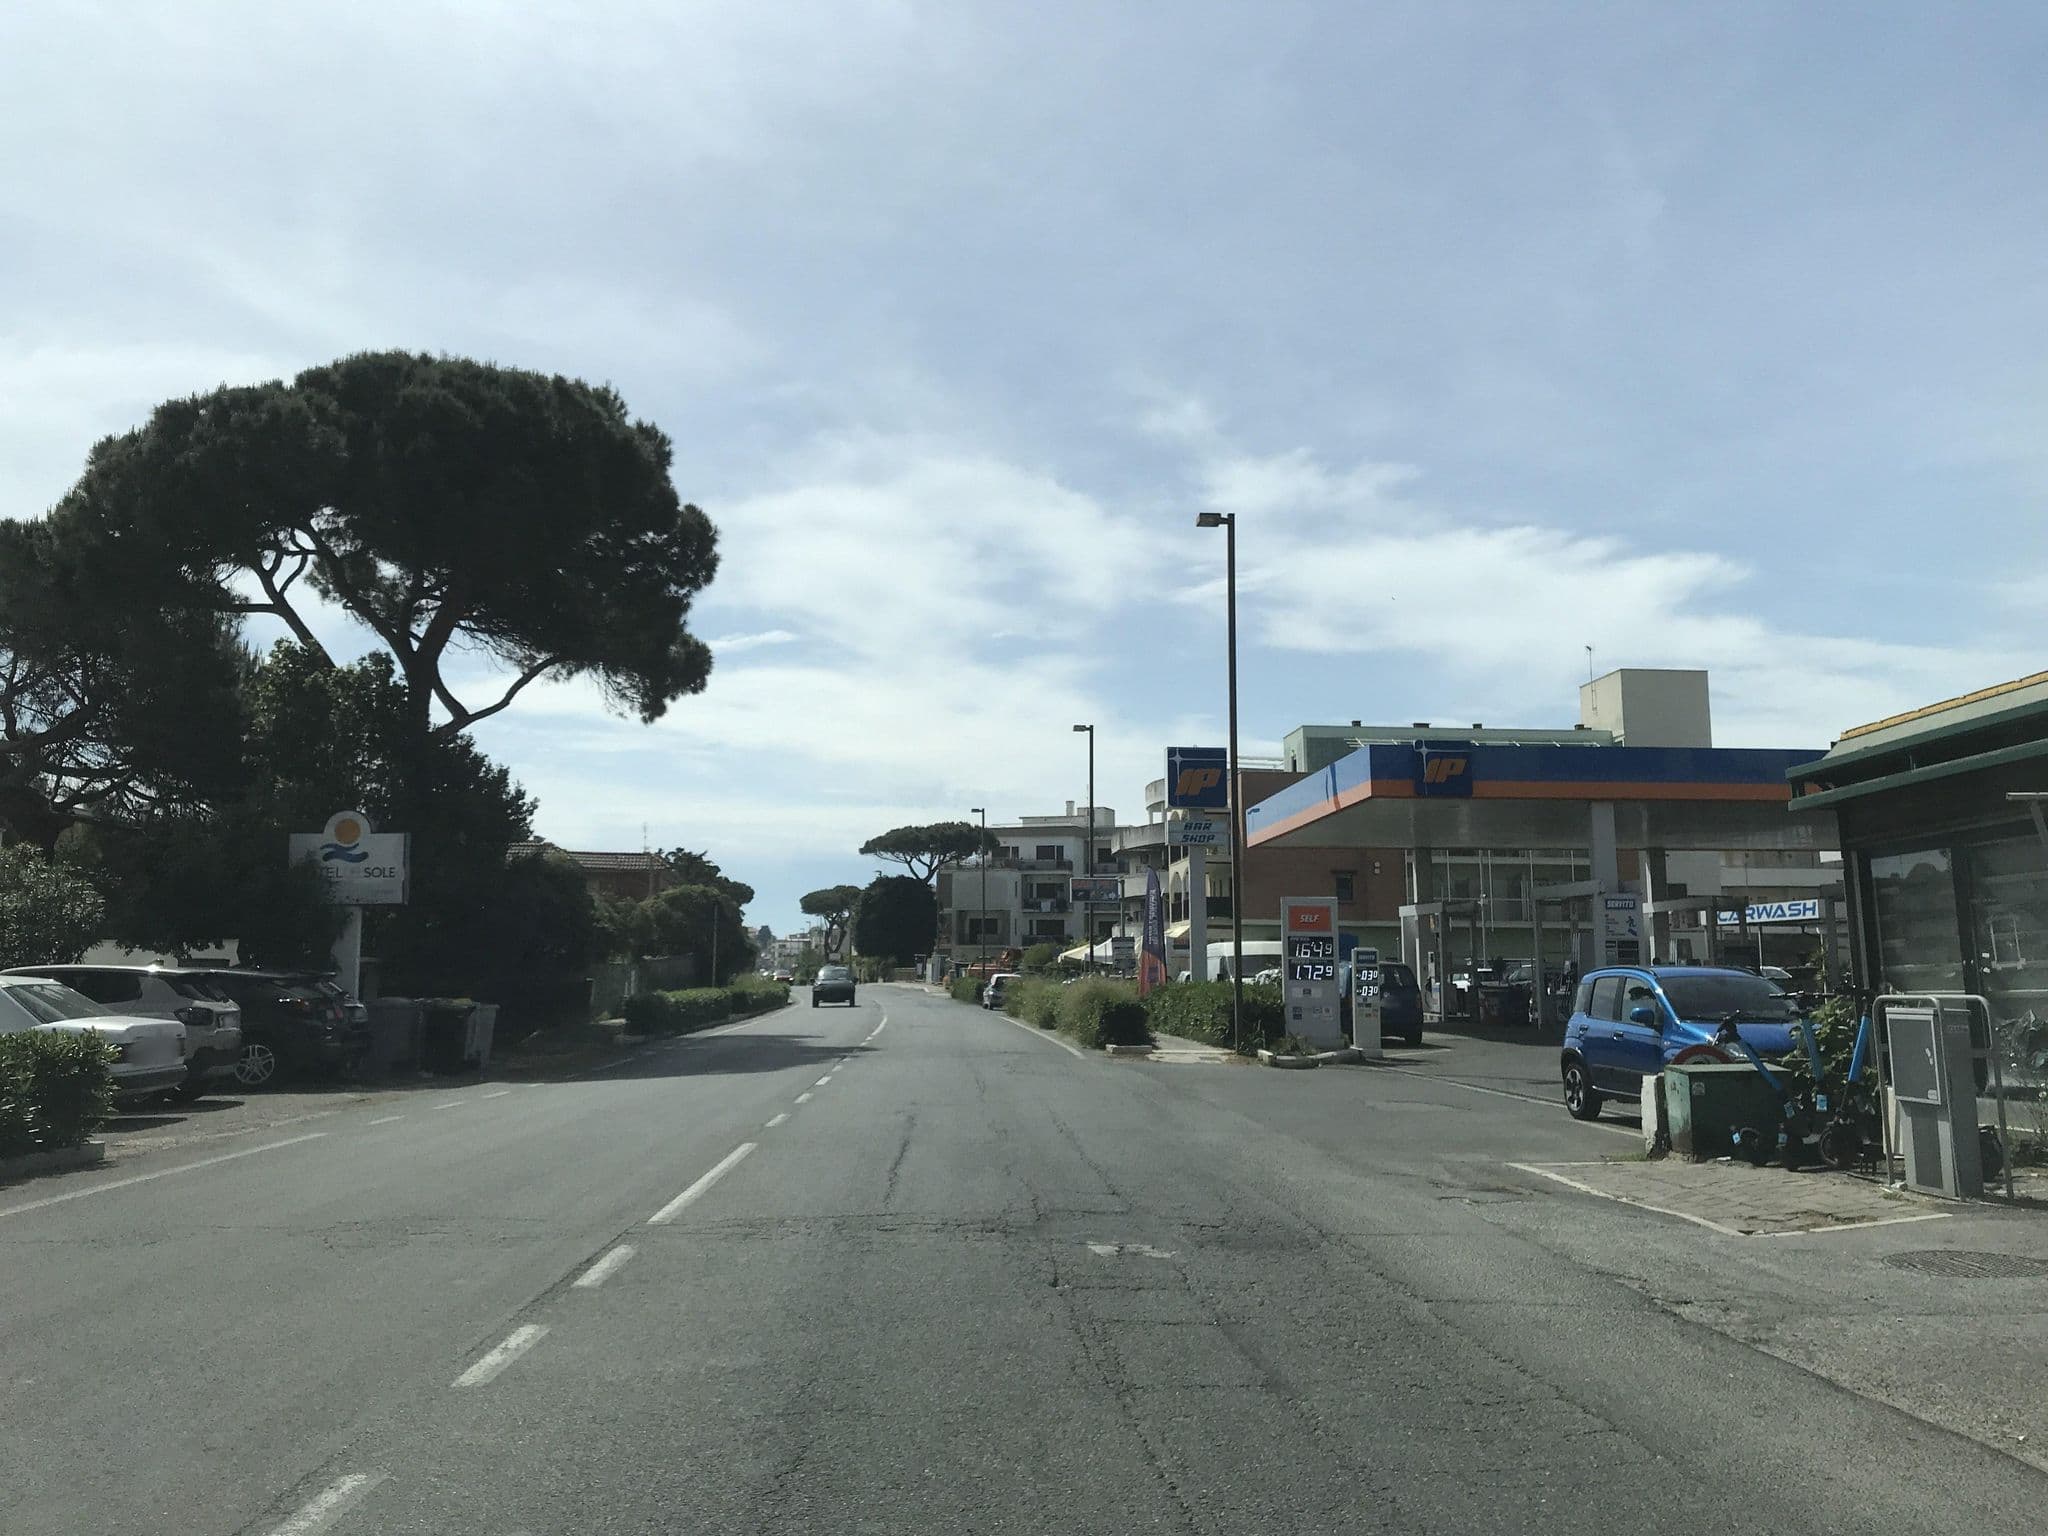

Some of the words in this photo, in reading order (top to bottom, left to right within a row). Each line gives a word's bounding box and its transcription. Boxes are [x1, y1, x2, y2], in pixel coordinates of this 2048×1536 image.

[1424, 758, 1467, 784] IP
[1175, 768, 1223, 796] IP
[1183, 822, 1213, 831] BAR
[1181, 834, 1216, 843] SHOP
[363, 866, 396, 878] SOLE
[1299, 914, 1321, 923] SELF
[1295, 965, 1334, 980] 1.729
